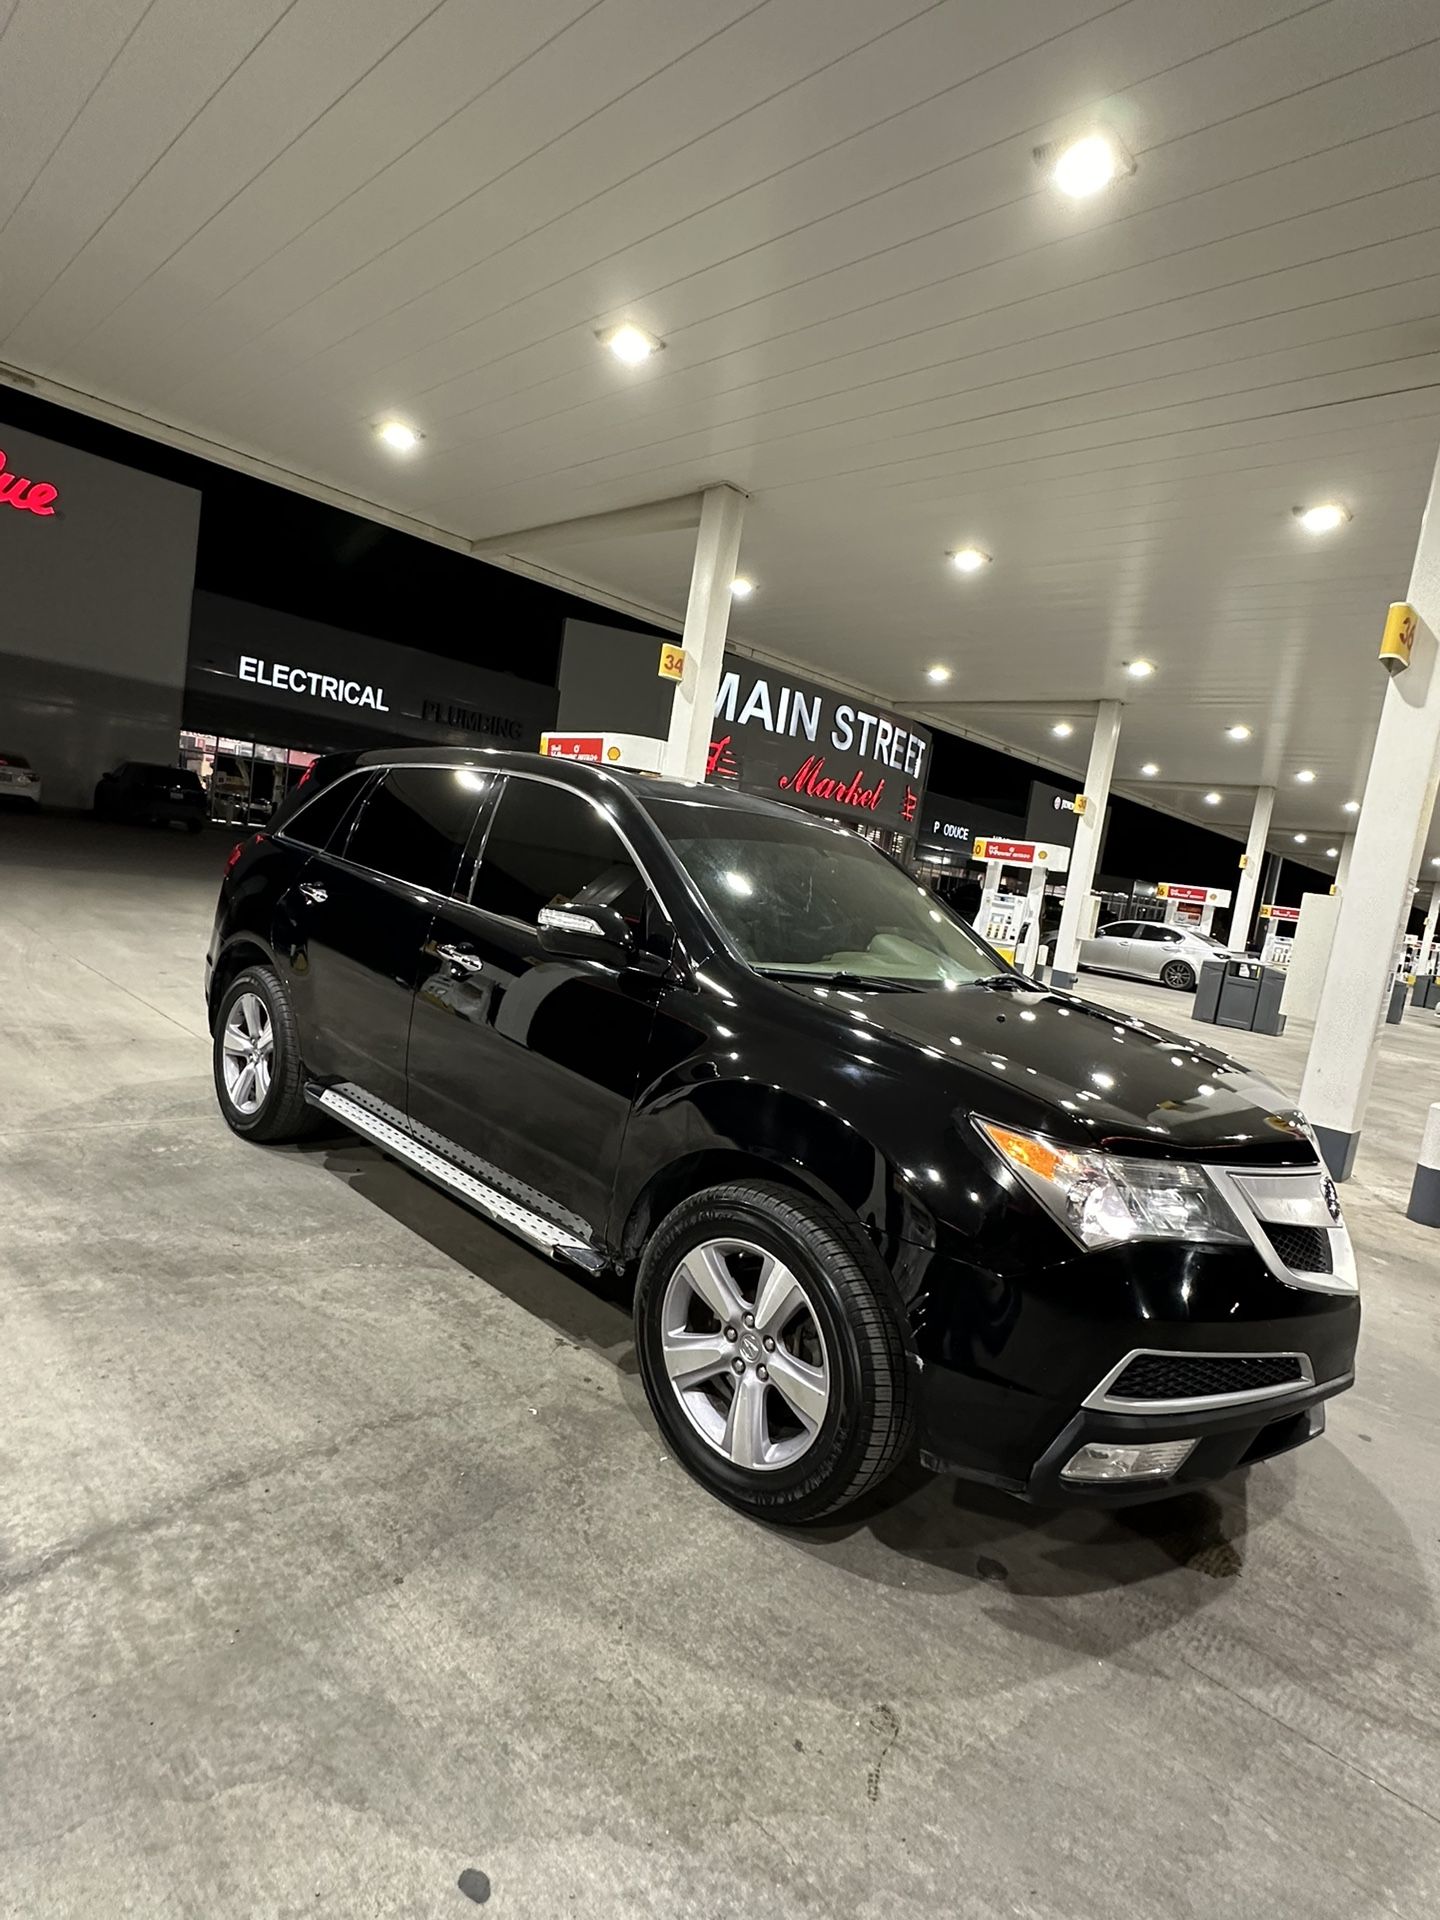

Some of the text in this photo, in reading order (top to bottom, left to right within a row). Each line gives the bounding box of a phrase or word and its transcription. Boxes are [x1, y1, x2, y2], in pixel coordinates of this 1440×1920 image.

[239, 655, 389, 712] ELECTRICAL
[664, 654, 684, 673] 34
[421, 699, 523, 740] PLUMBING
[831, 704, 926, 779] STREET
[778, 754, 885, 812] Market
